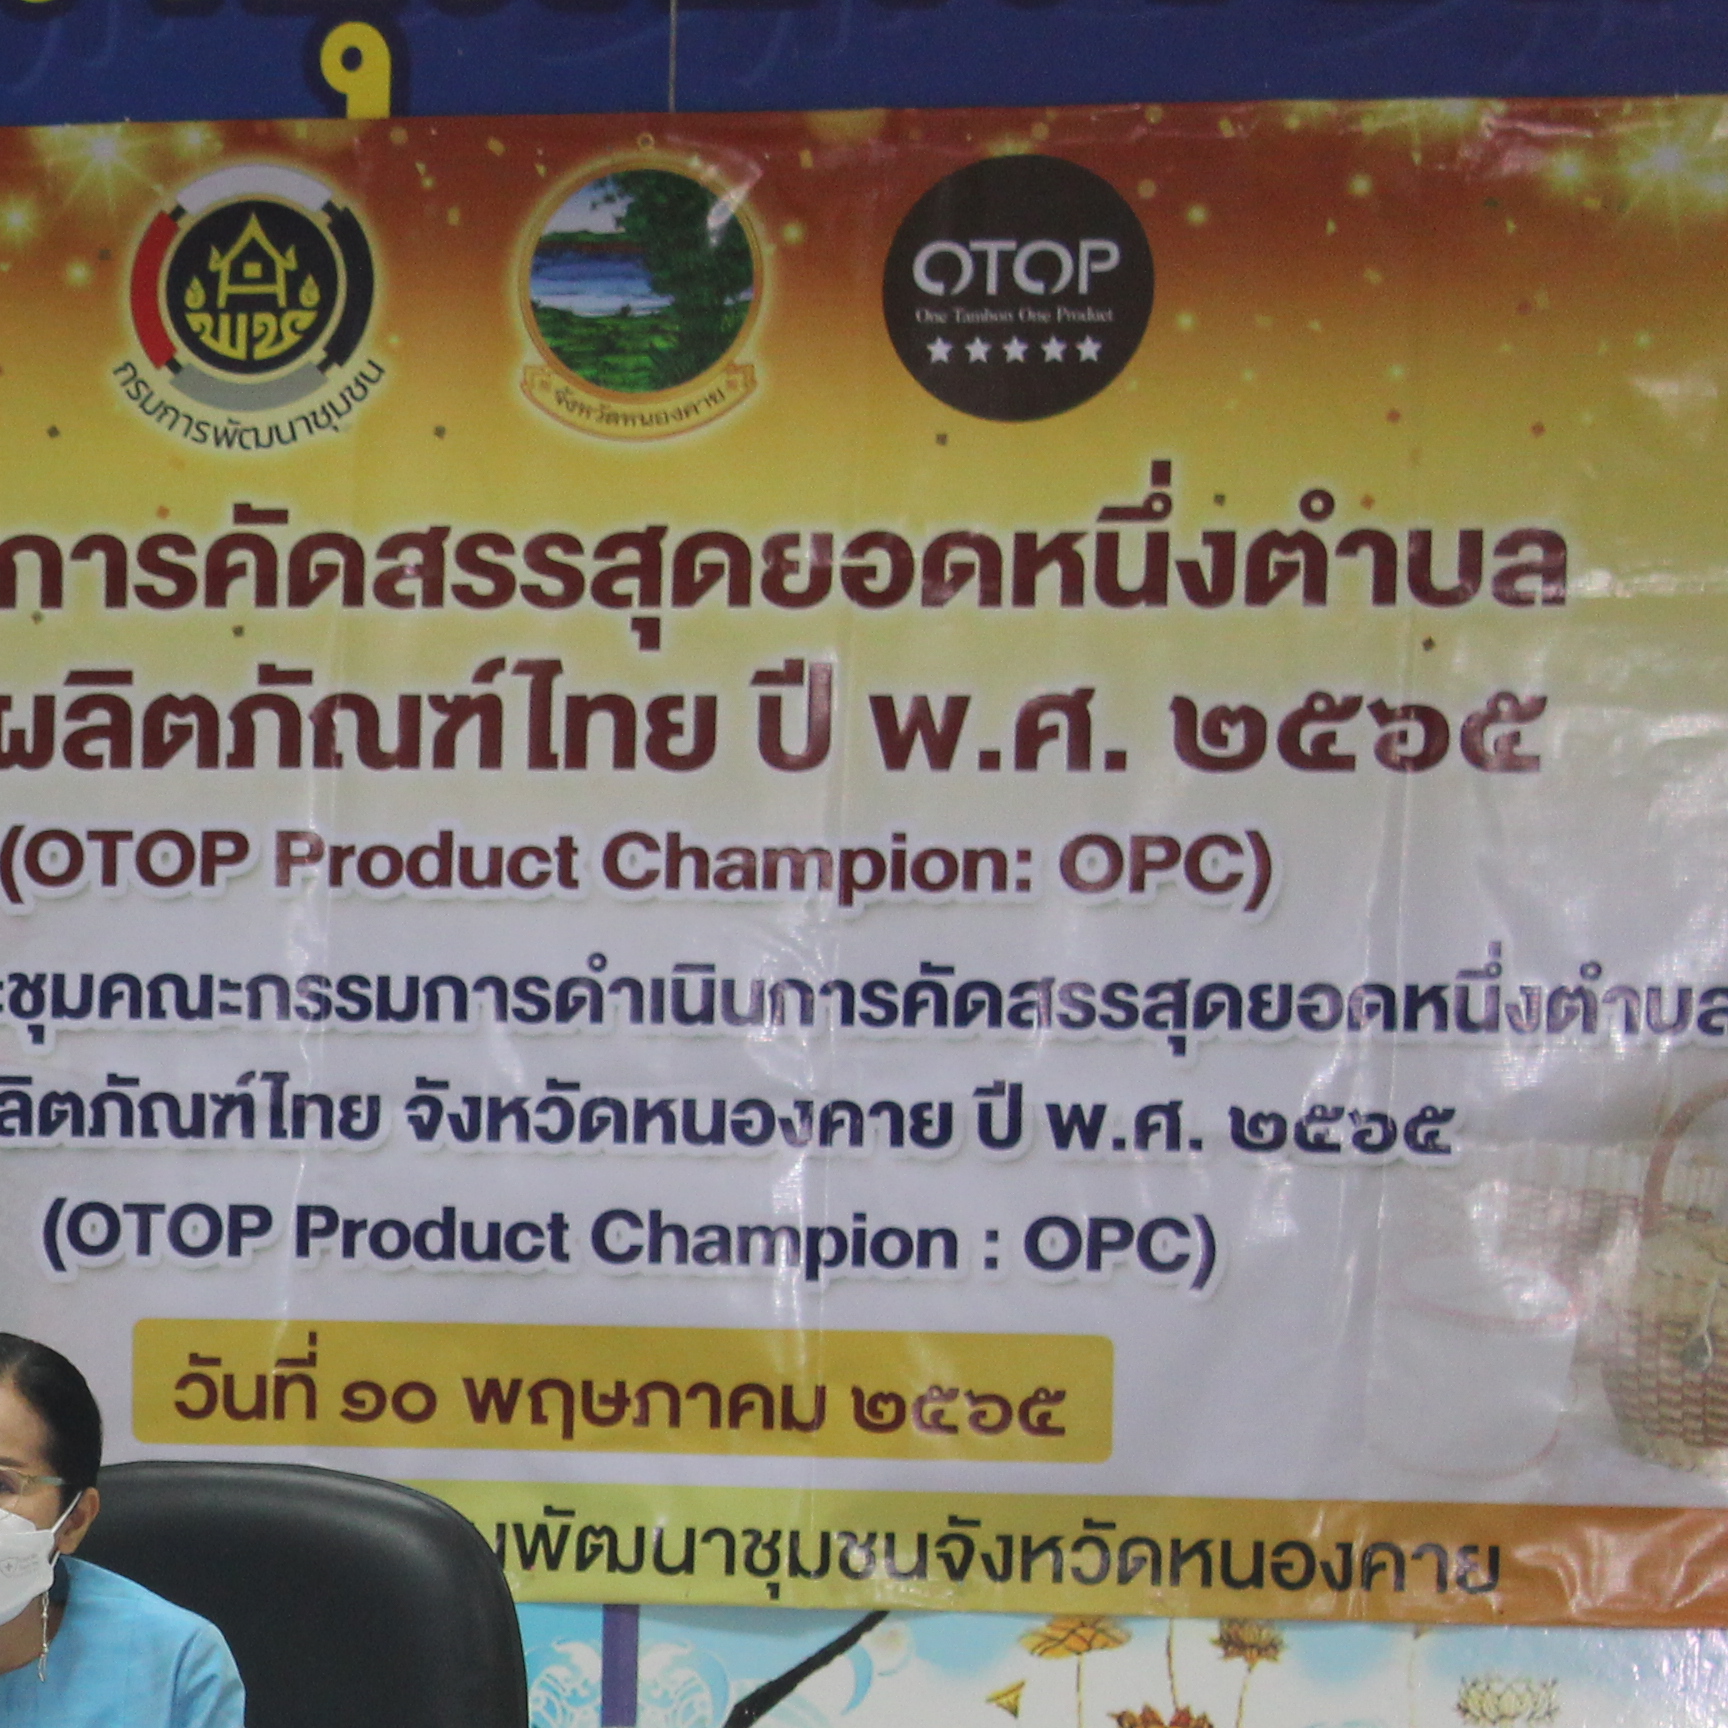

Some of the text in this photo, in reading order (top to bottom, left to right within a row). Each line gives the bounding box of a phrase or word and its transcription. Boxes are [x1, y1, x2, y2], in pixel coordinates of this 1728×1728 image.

[912, 238, 1121, 297] OTOP
[916, 305, 1114, 323] One Tambon One Product
[112, 359, 386, 450] กรมการพัฒนาชุมชน
[750, 658, 832, 772] ปี
[869, 687, 1128, 772] พ.ศ.
[1169, 690, 1548, 774] ๒๕๖๕
[275, 829, 580, 890] Product
[602, 829, 1032, 908] Champion:
[1059, 829, 1273, 912] OPC)
[406, 1075, 954, 1149] จังหวัดหนองคาย
[973, 1079, 1024, 1150] ปี
[1046, 1099, 1204, 1151] พ.ศ.
[1228, 1103, 1456, 1155] ๒๕๖๕
[43, 1196, 273, 1272] (OTOP
[295, 1204, 571, 1263] Product
[591, 1208, 959, 1282] Champion
[1024, 1214, 1217, 1290] OPC)
[173, 1331, 1068, 1441] วันที่ ๑๐ พฤษภาคม ๒๕๖๕
